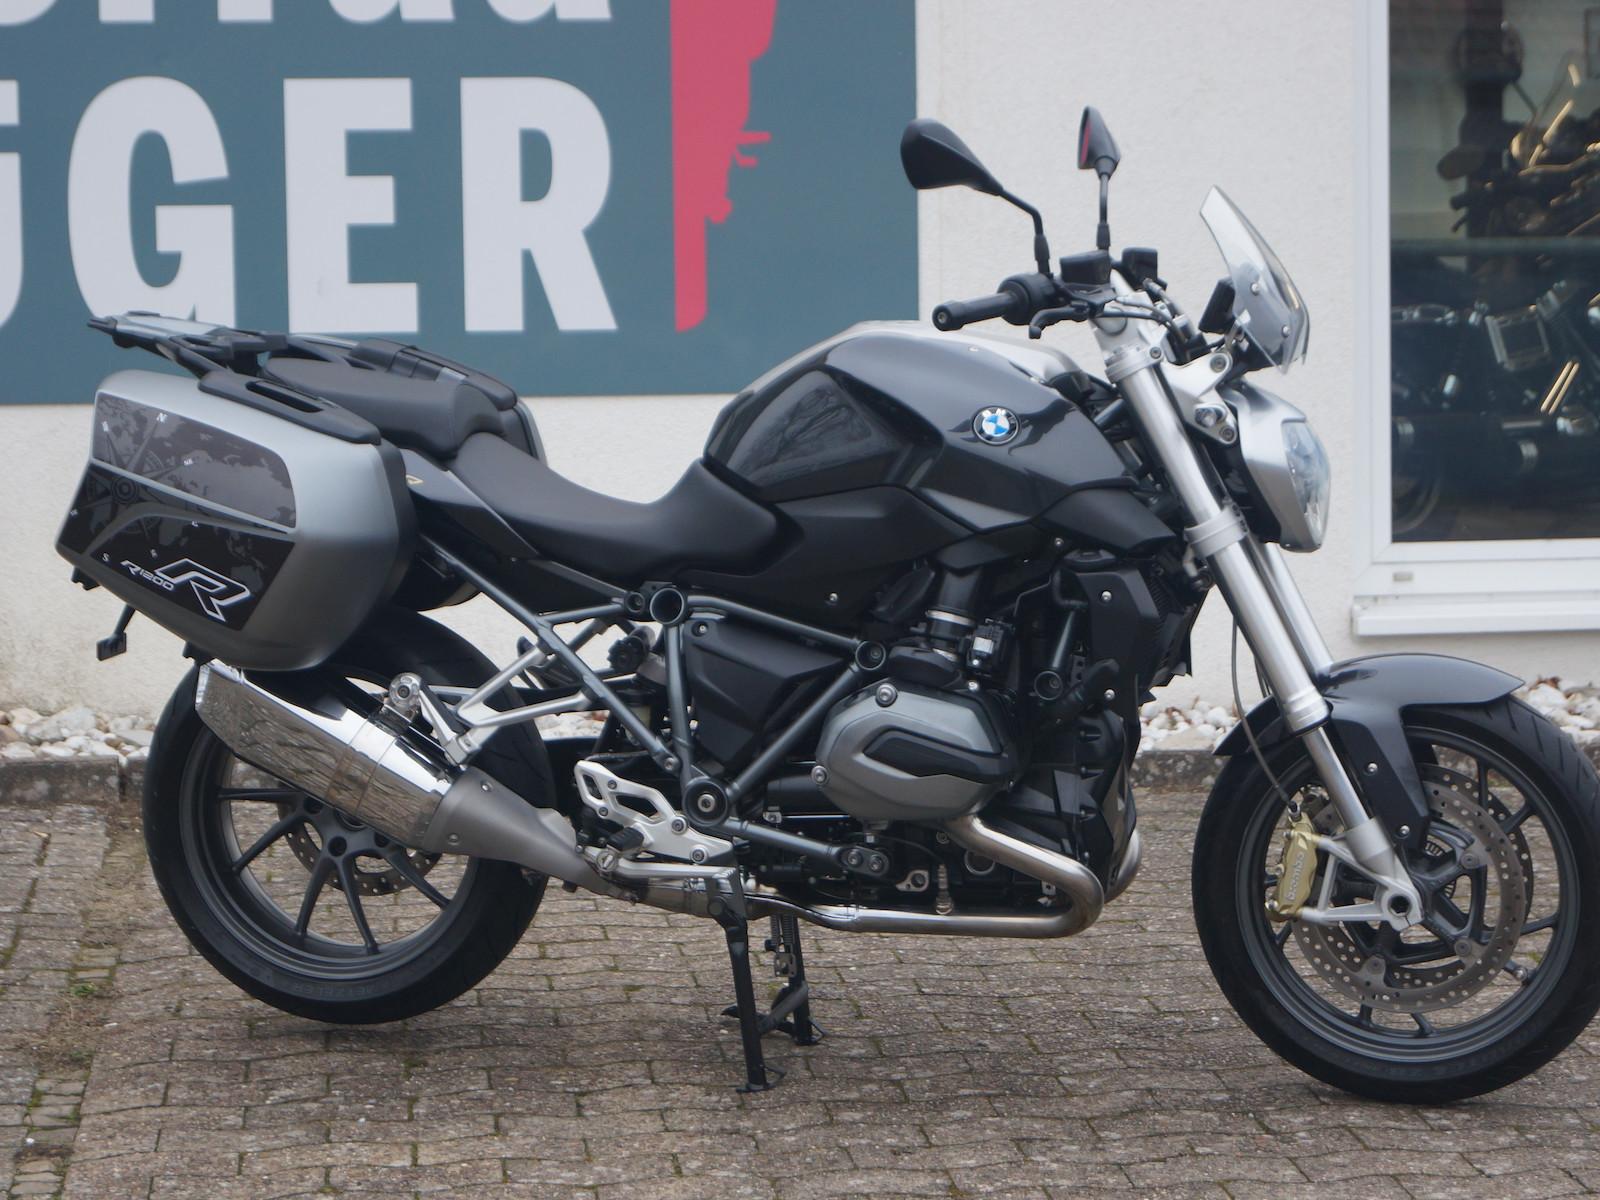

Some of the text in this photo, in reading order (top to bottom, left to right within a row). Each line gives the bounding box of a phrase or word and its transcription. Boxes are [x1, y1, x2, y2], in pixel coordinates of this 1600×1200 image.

[0, 76, 617, 333] GER
[120, 557, 251, 622] R1200 R
